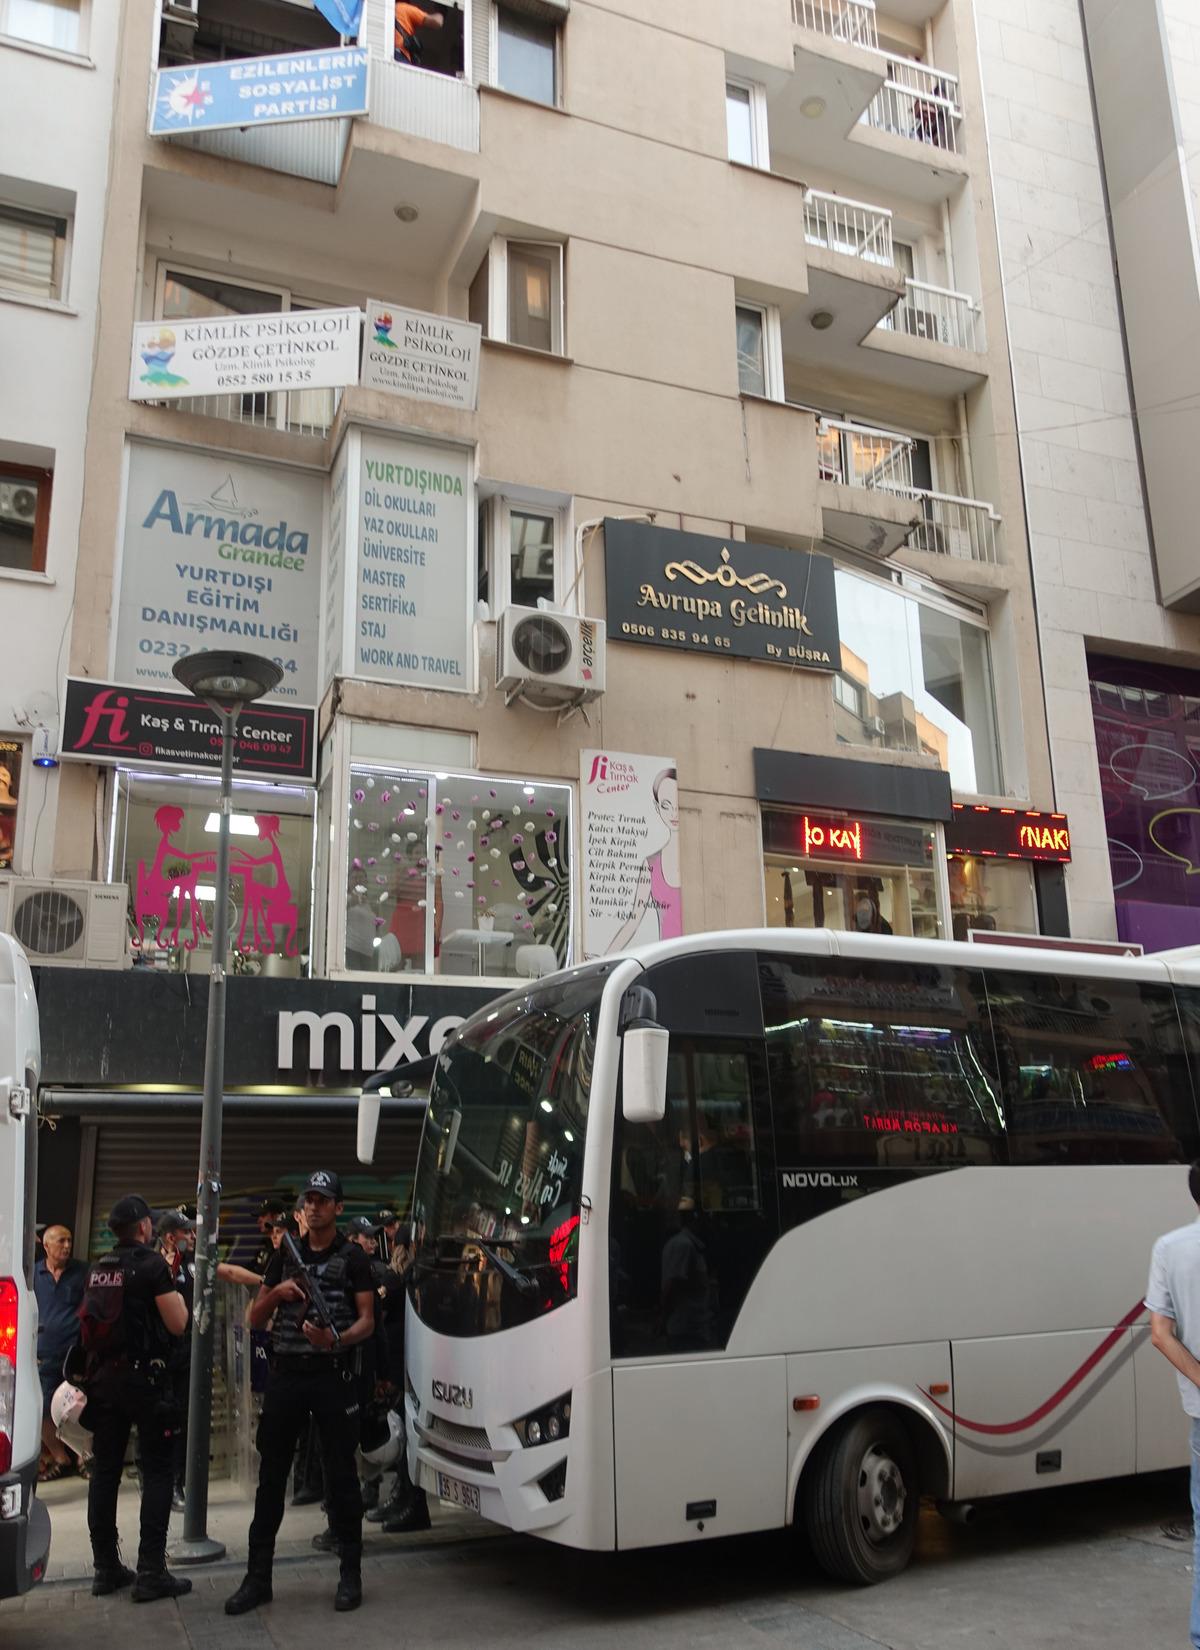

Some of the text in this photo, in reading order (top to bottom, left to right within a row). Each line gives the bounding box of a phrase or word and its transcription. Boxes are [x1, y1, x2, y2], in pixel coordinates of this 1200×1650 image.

[230, 53, 368, 80] EZİLENLERİN
[239, 75, 357, 99] SOSYALİST
[254, 95, 337, 117] PARTİSİ
[184, 315, 350, 341] KİMLİK PSİKOLOJİ
[405, 319, 453, 341] KİMLİK
[193, 339, 339, 361] GÖZDE ÇETİNKOL
[404, 335, 471, 362] PSİKOLOJİ
[242, 358, 272, 370] Klinik
[275, 357, 316, 369] Psikolog
[370, 352, 469, 382] GÖZDE ÇETİNKOL
[217, 370, 312, 388] 0552 580 15 35
[366, 459, 463, 496] YURTDIŞINDA
[365, 488, 436, 517] DİL OKULLARI
[142, 489, 309, 555] Armada
[364, 516, 438, 543] YAZ OKULLARI
[218, 543, 305, 571] Grandee
[363, 538, 425, 566] ÜNİVERSİTE
[176, 564, 273, 594] YURTDIŞI
[362, 568, 405, 589] MASTER
[187, 587, 260, 614] EĞİTİM
[362, 591, 416, 617] SERTİFİKA
[637, 584, 814, 636] Avrupa Gelinlik
[142, 607, 299, 643] DANIŞMANLIĞI
[361, 621, 386, 639] STAJ
[622, 622, 731, 648] 0506 835 94 65
[139, 639, 191, 658] 0232
[766, 643, 830, 663] By BÜŞRA
[360, 648, 461, 676] WORK AND TRAVEL
[73, 689, 129, 749] fi
[141, 714, 170, 731] Kaş
[174, 718, 185, 731] &
[242, 726, 292, 743] Center
[155, 746, 240, 764] fikasvetirnakcener
[609, 761, 627, 774] Kaş
[610, 771, 638, 784] Tırnak
[588, 811, 647, 825] Protez Tırnak
[588, 823, 648, 838] Kalıcı Makyaj
[588, 846, 604, 857] Cilt
[610, 837, 637, 849] Kirpik
[589, 859, 616, 872] Kirpik
[589, 872, 651, 886] Kirpik Keratin
[589, 884, 633, 897] Kalıcı Oje
[589, 896, 629, 908] Manikür
[432, 1379, 473, 1409] ISUZU
